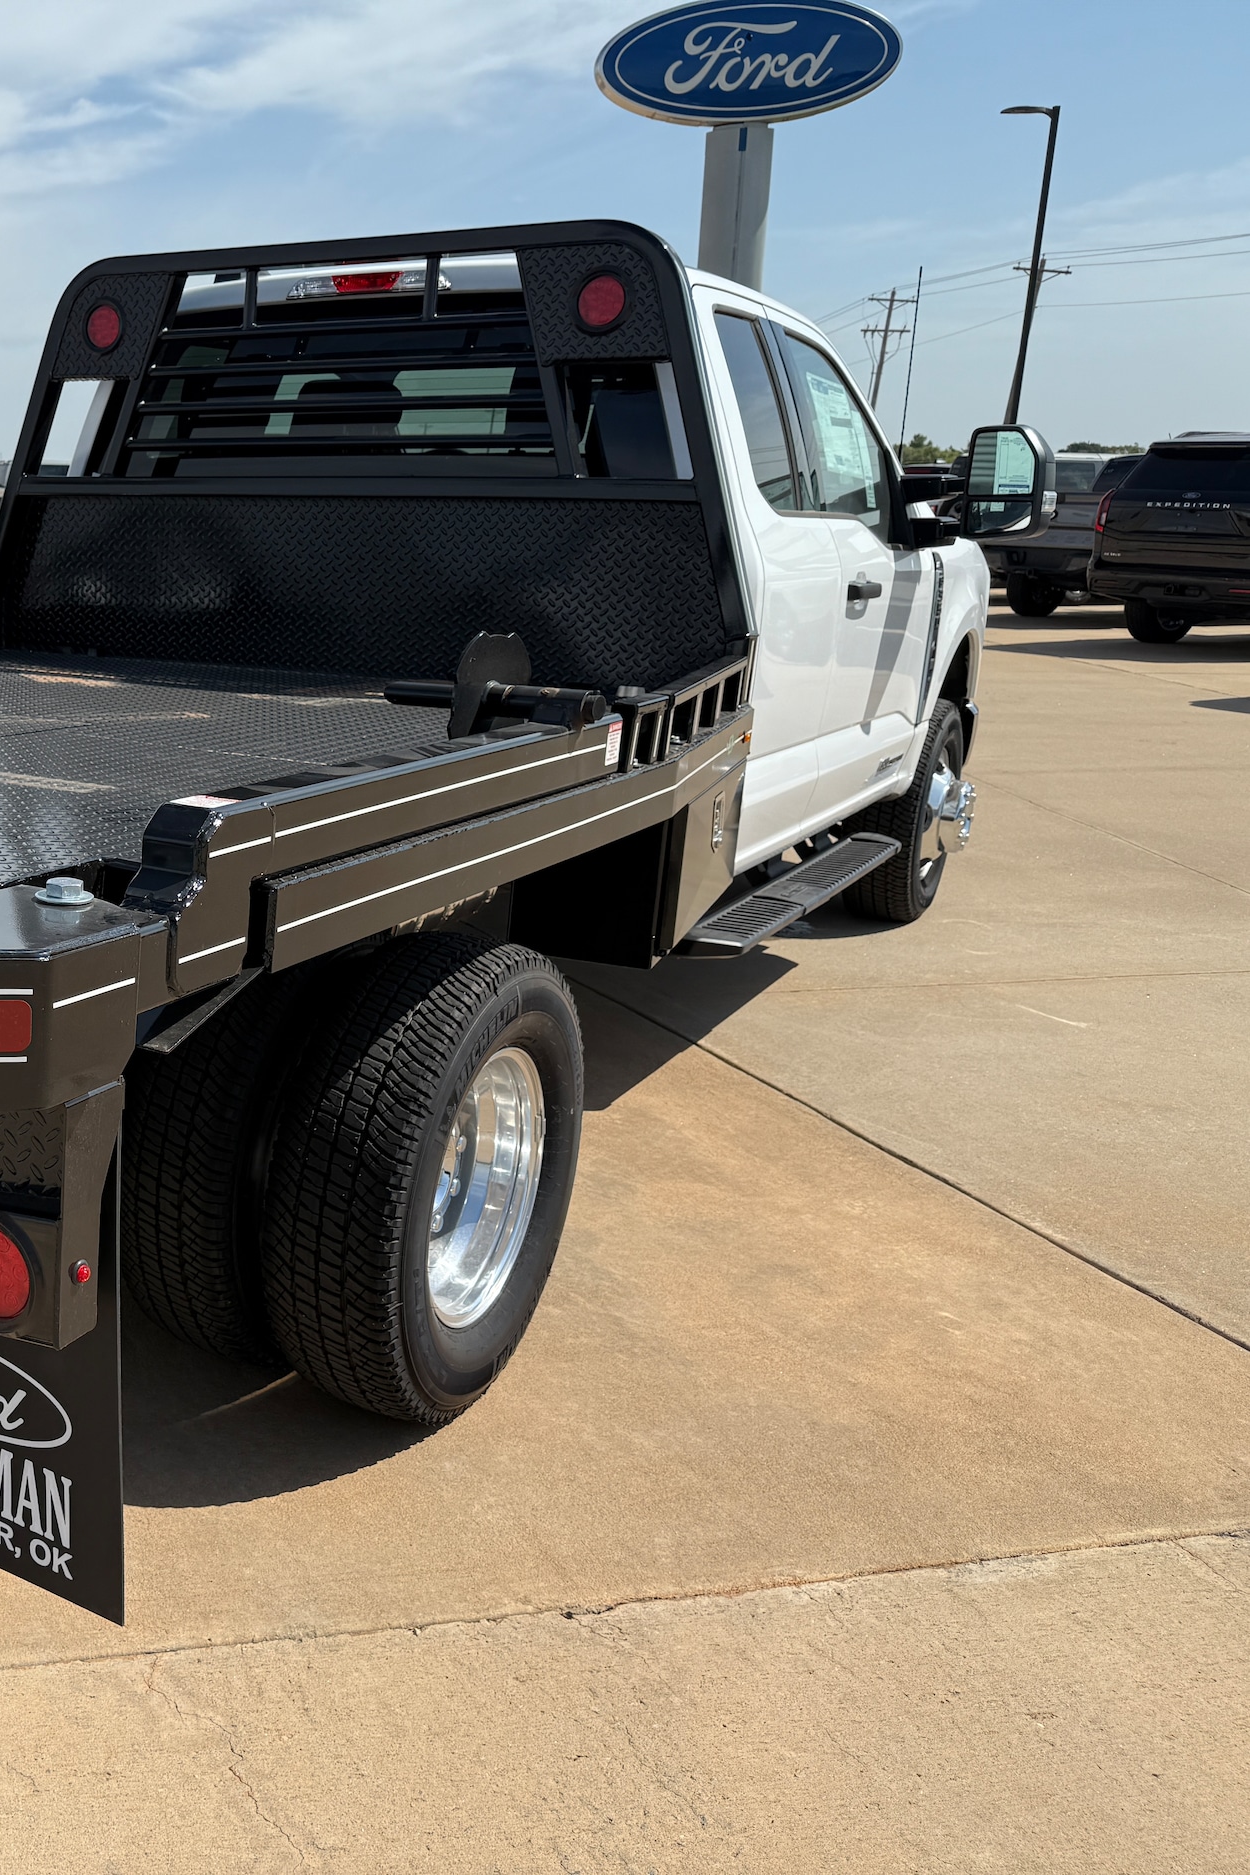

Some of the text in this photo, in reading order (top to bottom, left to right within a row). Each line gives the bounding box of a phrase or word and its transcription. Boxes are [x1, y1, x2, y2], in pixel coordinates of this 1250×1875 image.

[664, 20, 841, 95] Ford
[1146, 501, 1232, 510] EXPEDITION
[454, 996, 521, 1104] MICHELIN
[29, 1538, 74, 1581] OK
